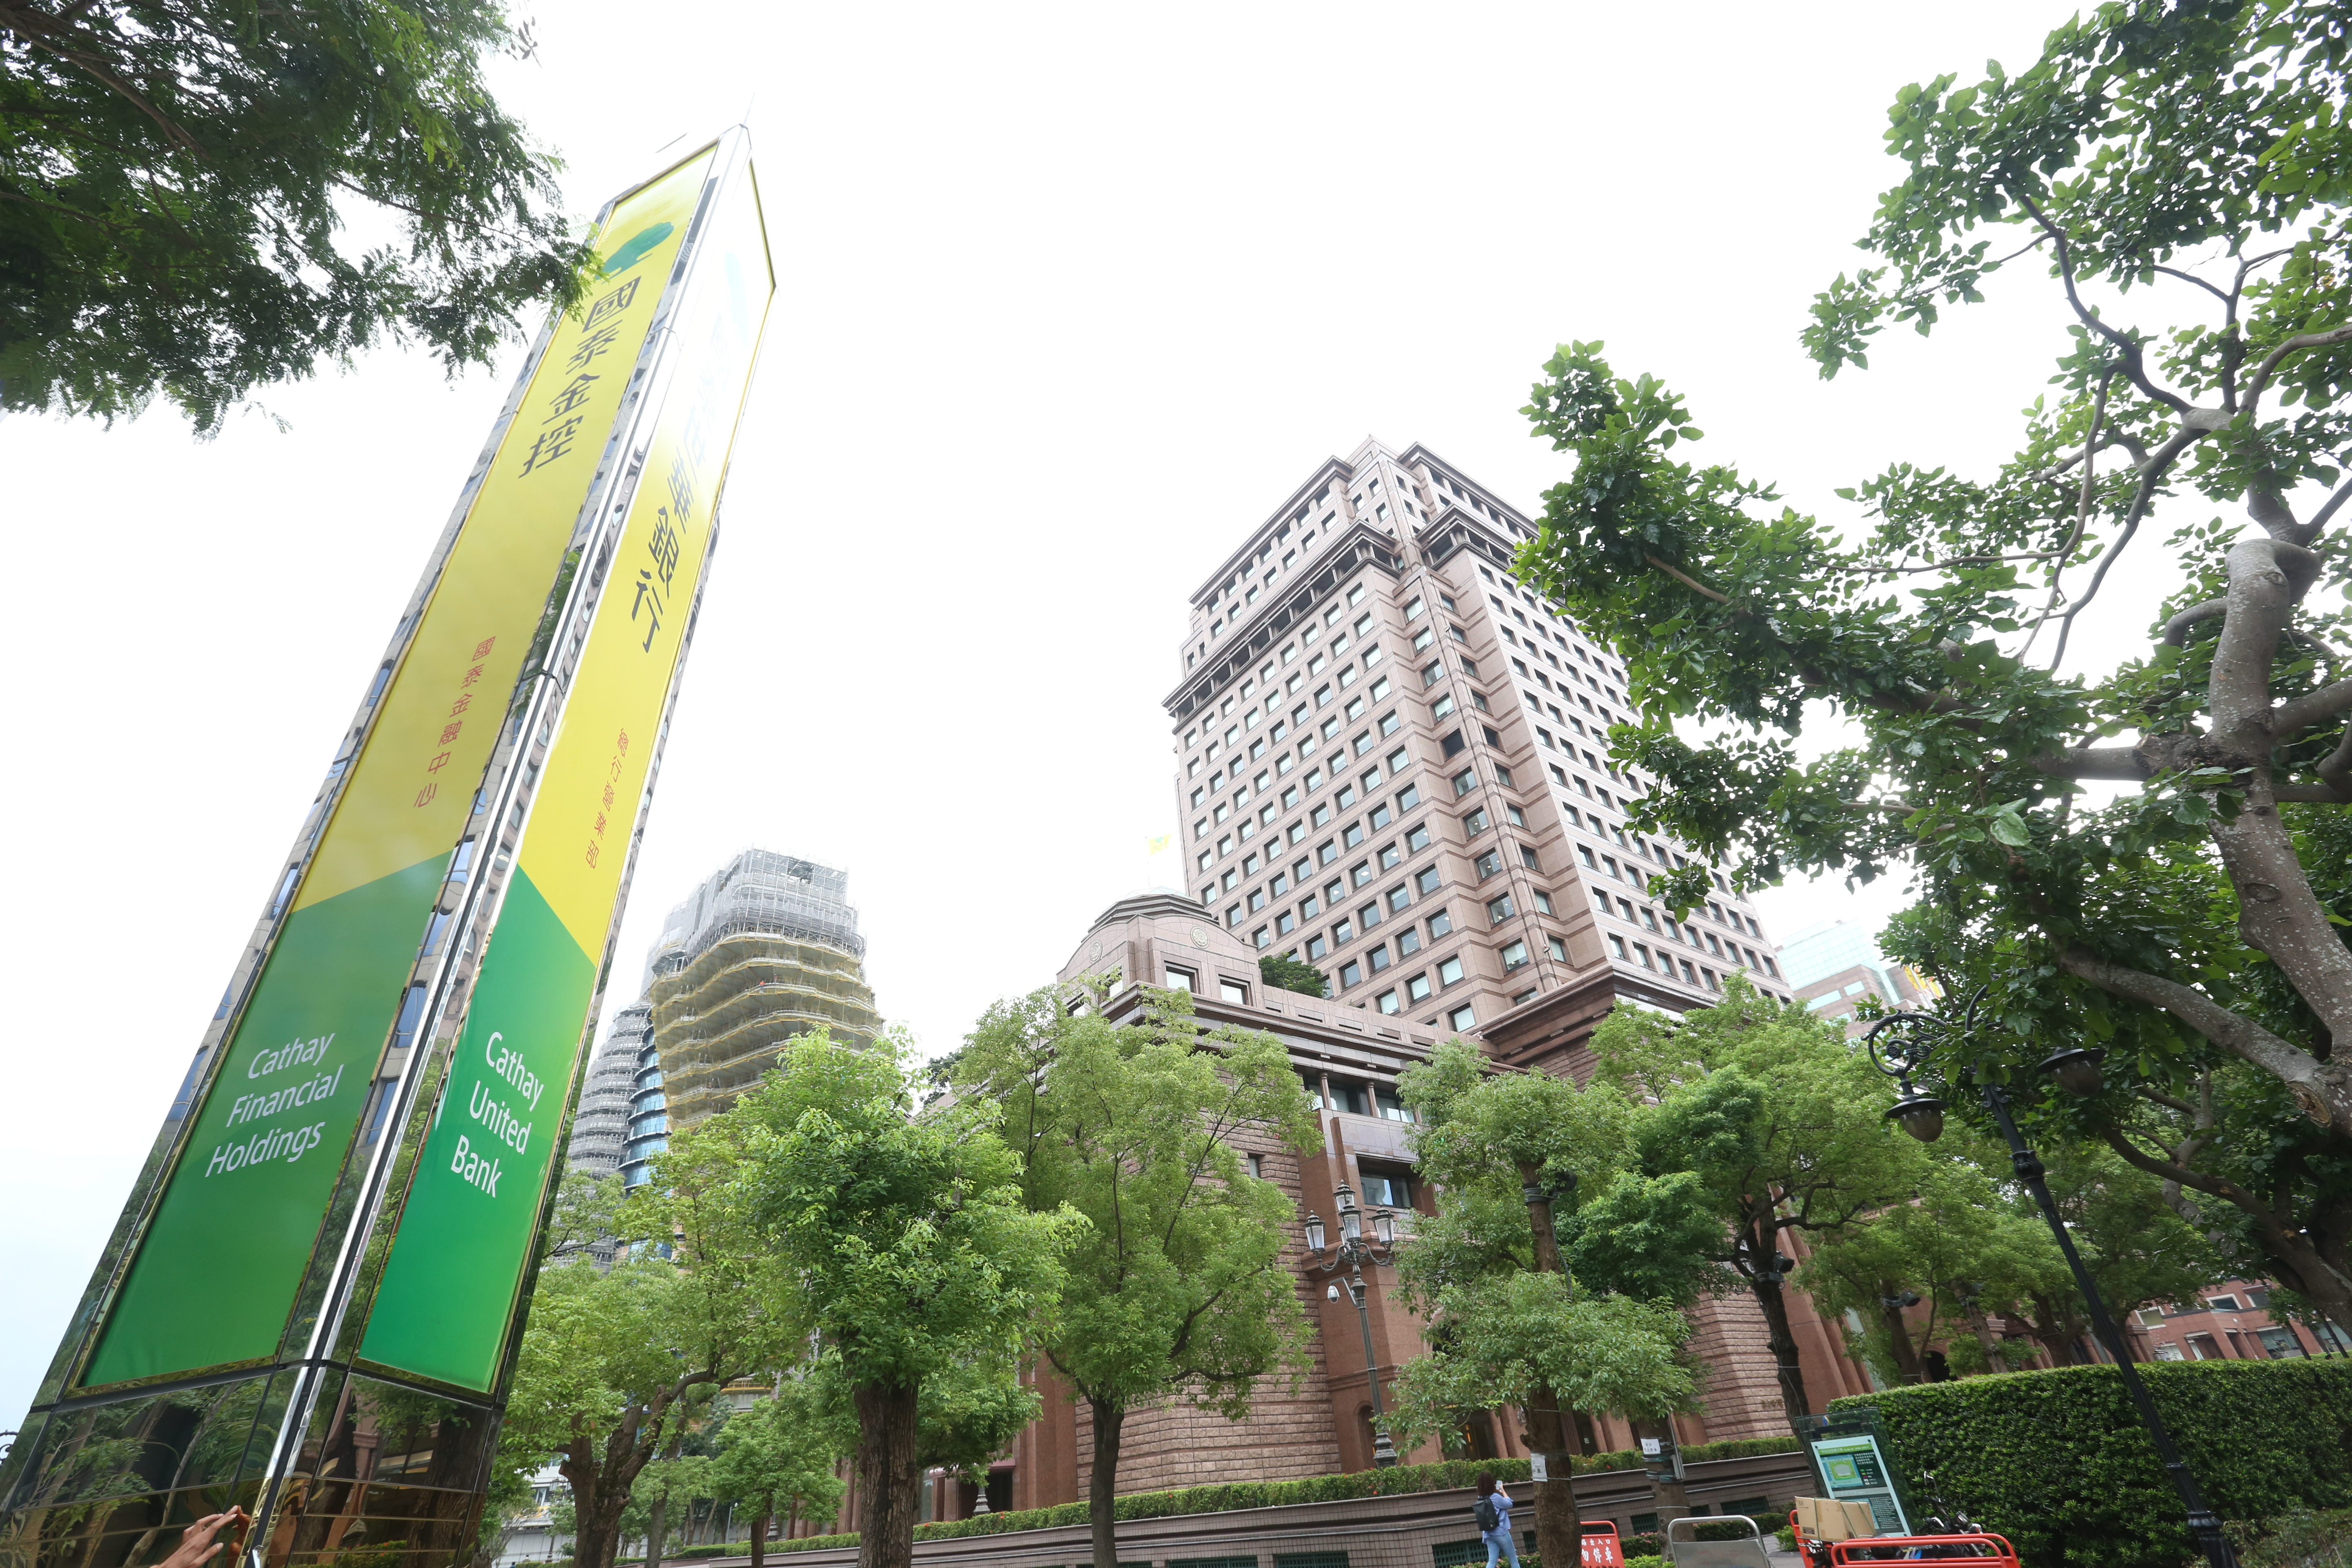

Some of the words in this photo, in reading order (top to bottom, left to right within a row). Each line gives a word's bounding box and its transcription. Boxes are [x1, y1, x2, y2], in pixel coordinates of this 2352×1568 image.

[519, 276, 641, 478] 國泰金控
[413, 636, 496, 808] 國泰金融中心
[586, 728, 628, 869] 總行營業部
[247, 1033, 335, 1080] Cathay
[486, 1031, 544, 1112] Cathay
[226, 1064, 344, 1128] Financial
[470, 1080, 532, 1155] United
[205, 1121, 326, 1178] Holdings
[451, 1134, 502, 1198] Bank
